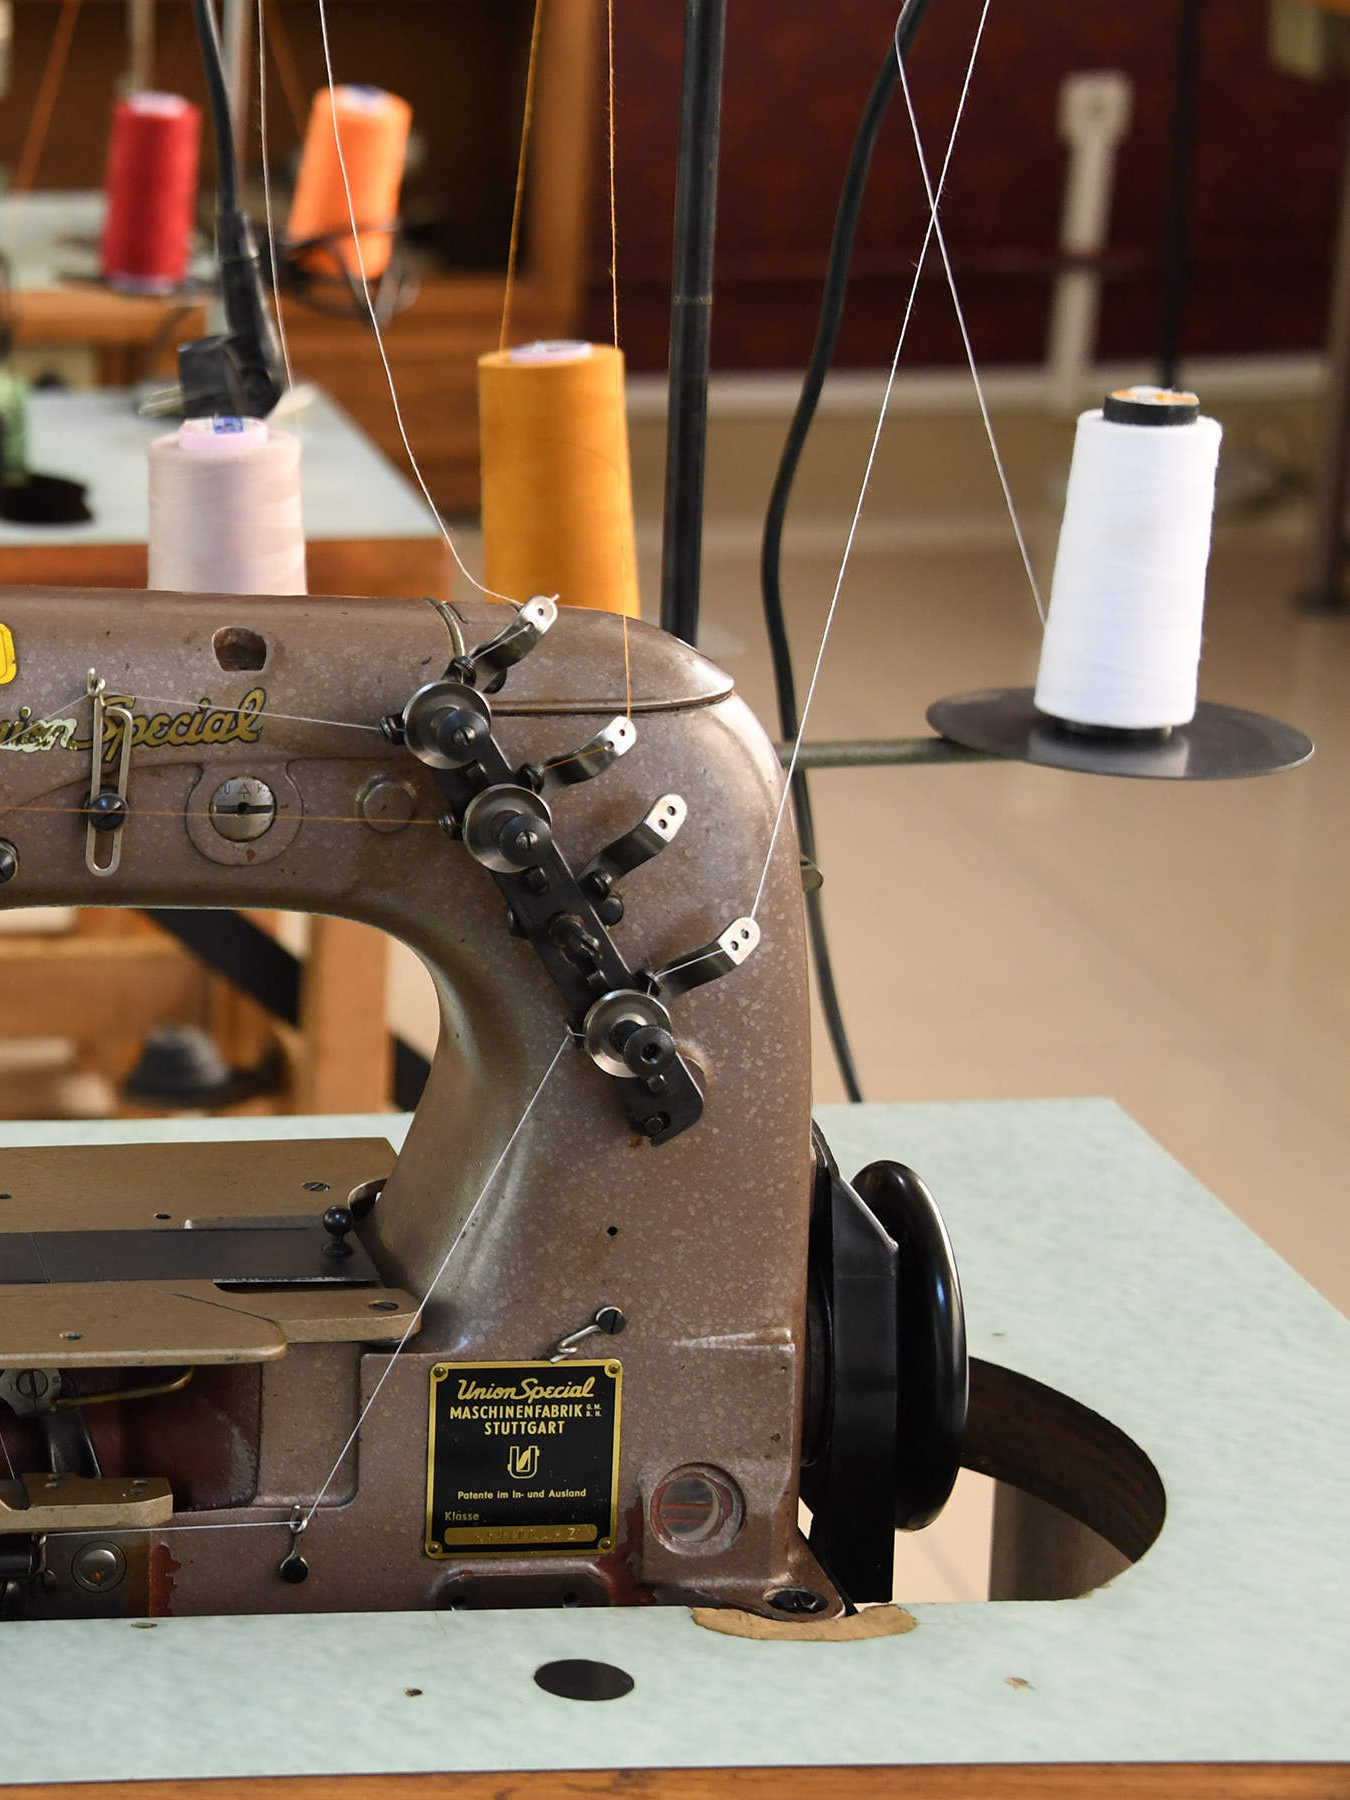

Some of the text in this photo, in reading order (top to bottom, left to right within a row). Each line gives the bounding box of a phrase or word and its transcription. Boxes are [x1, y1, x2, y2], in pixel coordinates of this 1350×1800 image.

[84, 687, 267, 763] Special
[457, 1376, 596, 1404] Union Special
[449, 1403, 583, 1420] MASCHINENFABRIK
[484, 1420, 565, 1436] STUTTGART
[457, 1488, 587, 1500] Patente im In- und Ausland
[444, 1511, 480, 1521] Klasse
